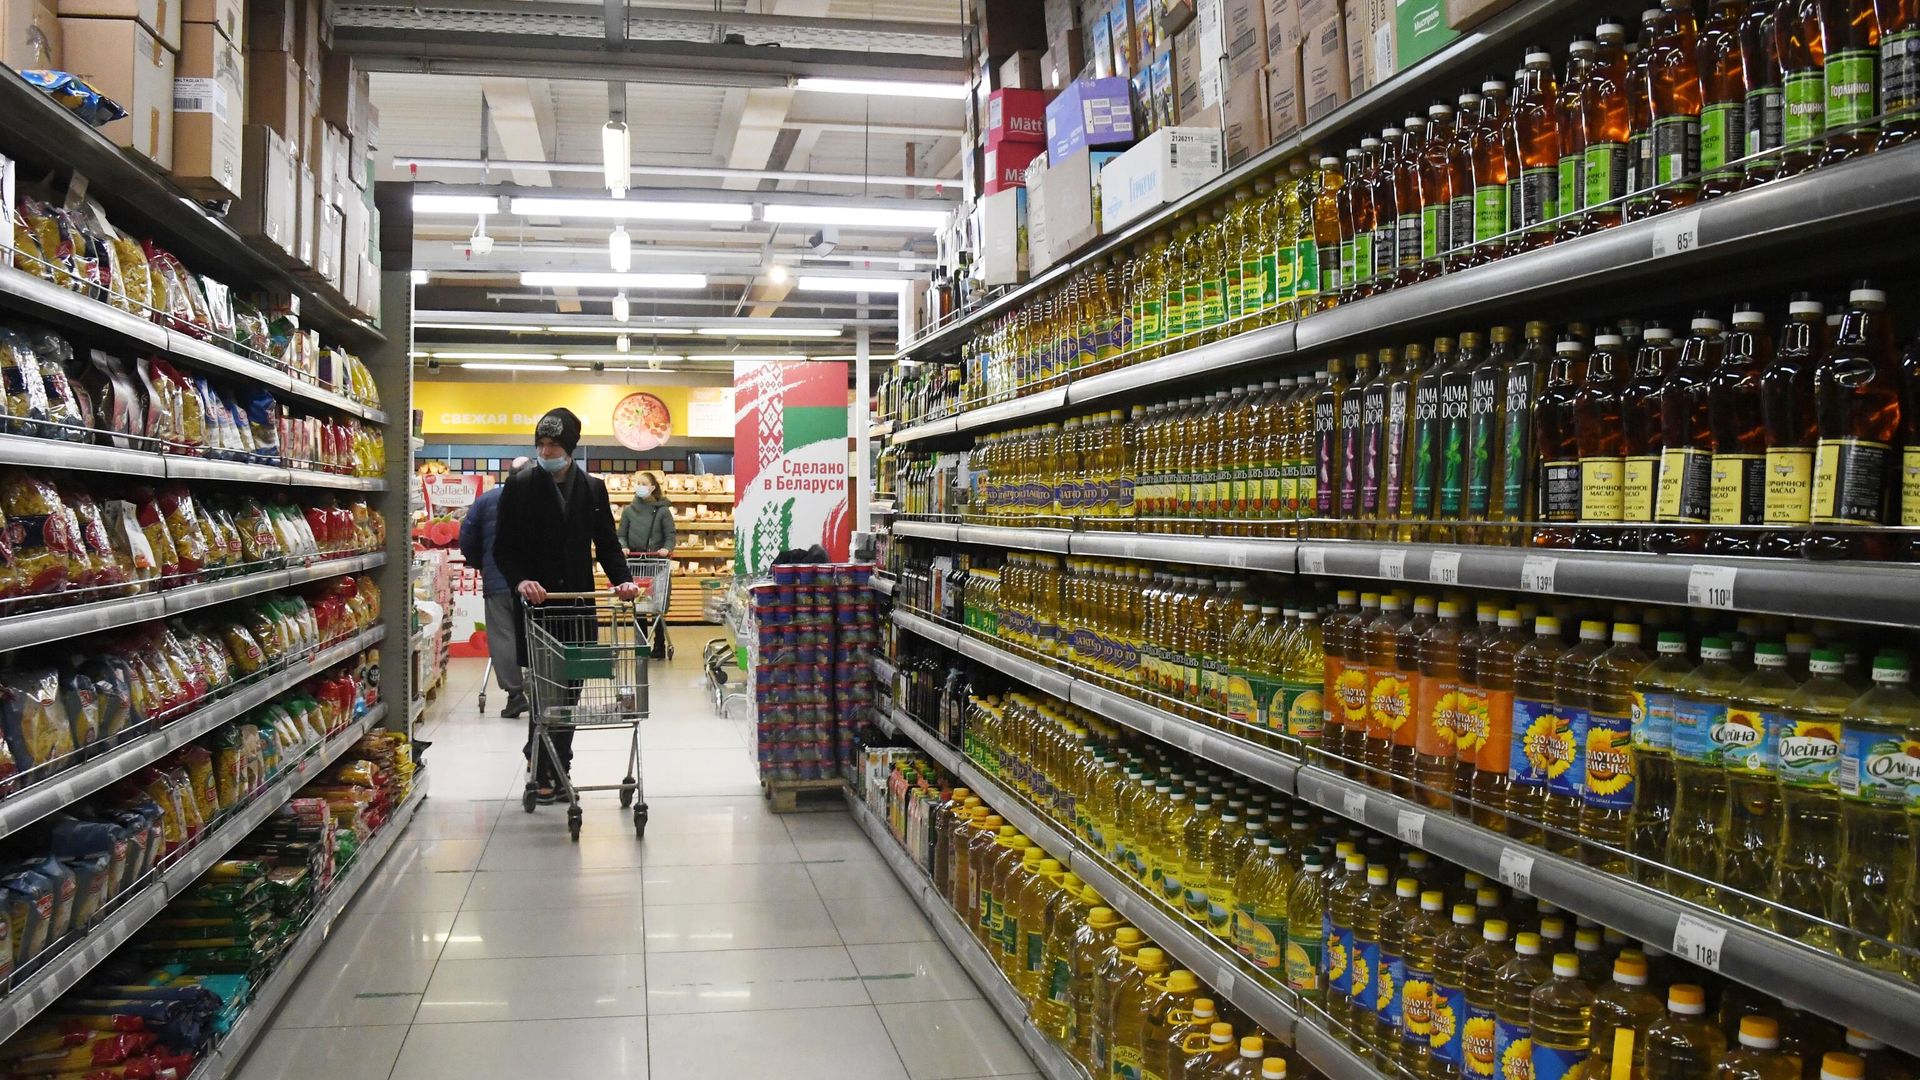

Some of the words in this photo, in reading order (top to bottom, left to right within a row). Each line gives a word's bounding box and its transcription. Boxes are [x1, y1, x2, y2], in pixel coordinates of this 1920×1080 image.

[1831, 83, 1870, 98] Горлинка
[1790, 103, 1825, 116] Горлинк
[1473, 380, 1494, 397] ALMA
[1507, 375, 1527, 394] ALMA
[1366, 394, 1383, 408] ALMA
[1417, 387, 1437, 403] ALMA
[1443, 386, 1467, 401] ALMA
[1317, 403, 1333, 417] ALMA
[1343, 400, 1360, 414] ALMA
[1472, 397, 1493, 415] DOR
[1506, 393, 1527, 412] DOR
[1365, 409, 1382, 424] DOR
[1416, 403, 1436, 420] DOR
[1442, 402, 1467, 419] DOR
[441, 413, 508, 425] СВЕЖАЯ
[1316, 418, 1333, 432] DOR
[1342, 414, 1359, 429] DOR
[783, 460, 844, 476] Сделано
[431, 485, 475, 496] Raffaello
[764, 479, 771, 490] в
[777, 476, 843, 493] Беларуси
[1708, 588, 1726, 606] 110
[1779, 740, 1838, 757] Олейна
[1586, 761, 1632, 774] ЕМЕЧКА
[1696, 944, 1713, 966] 118
